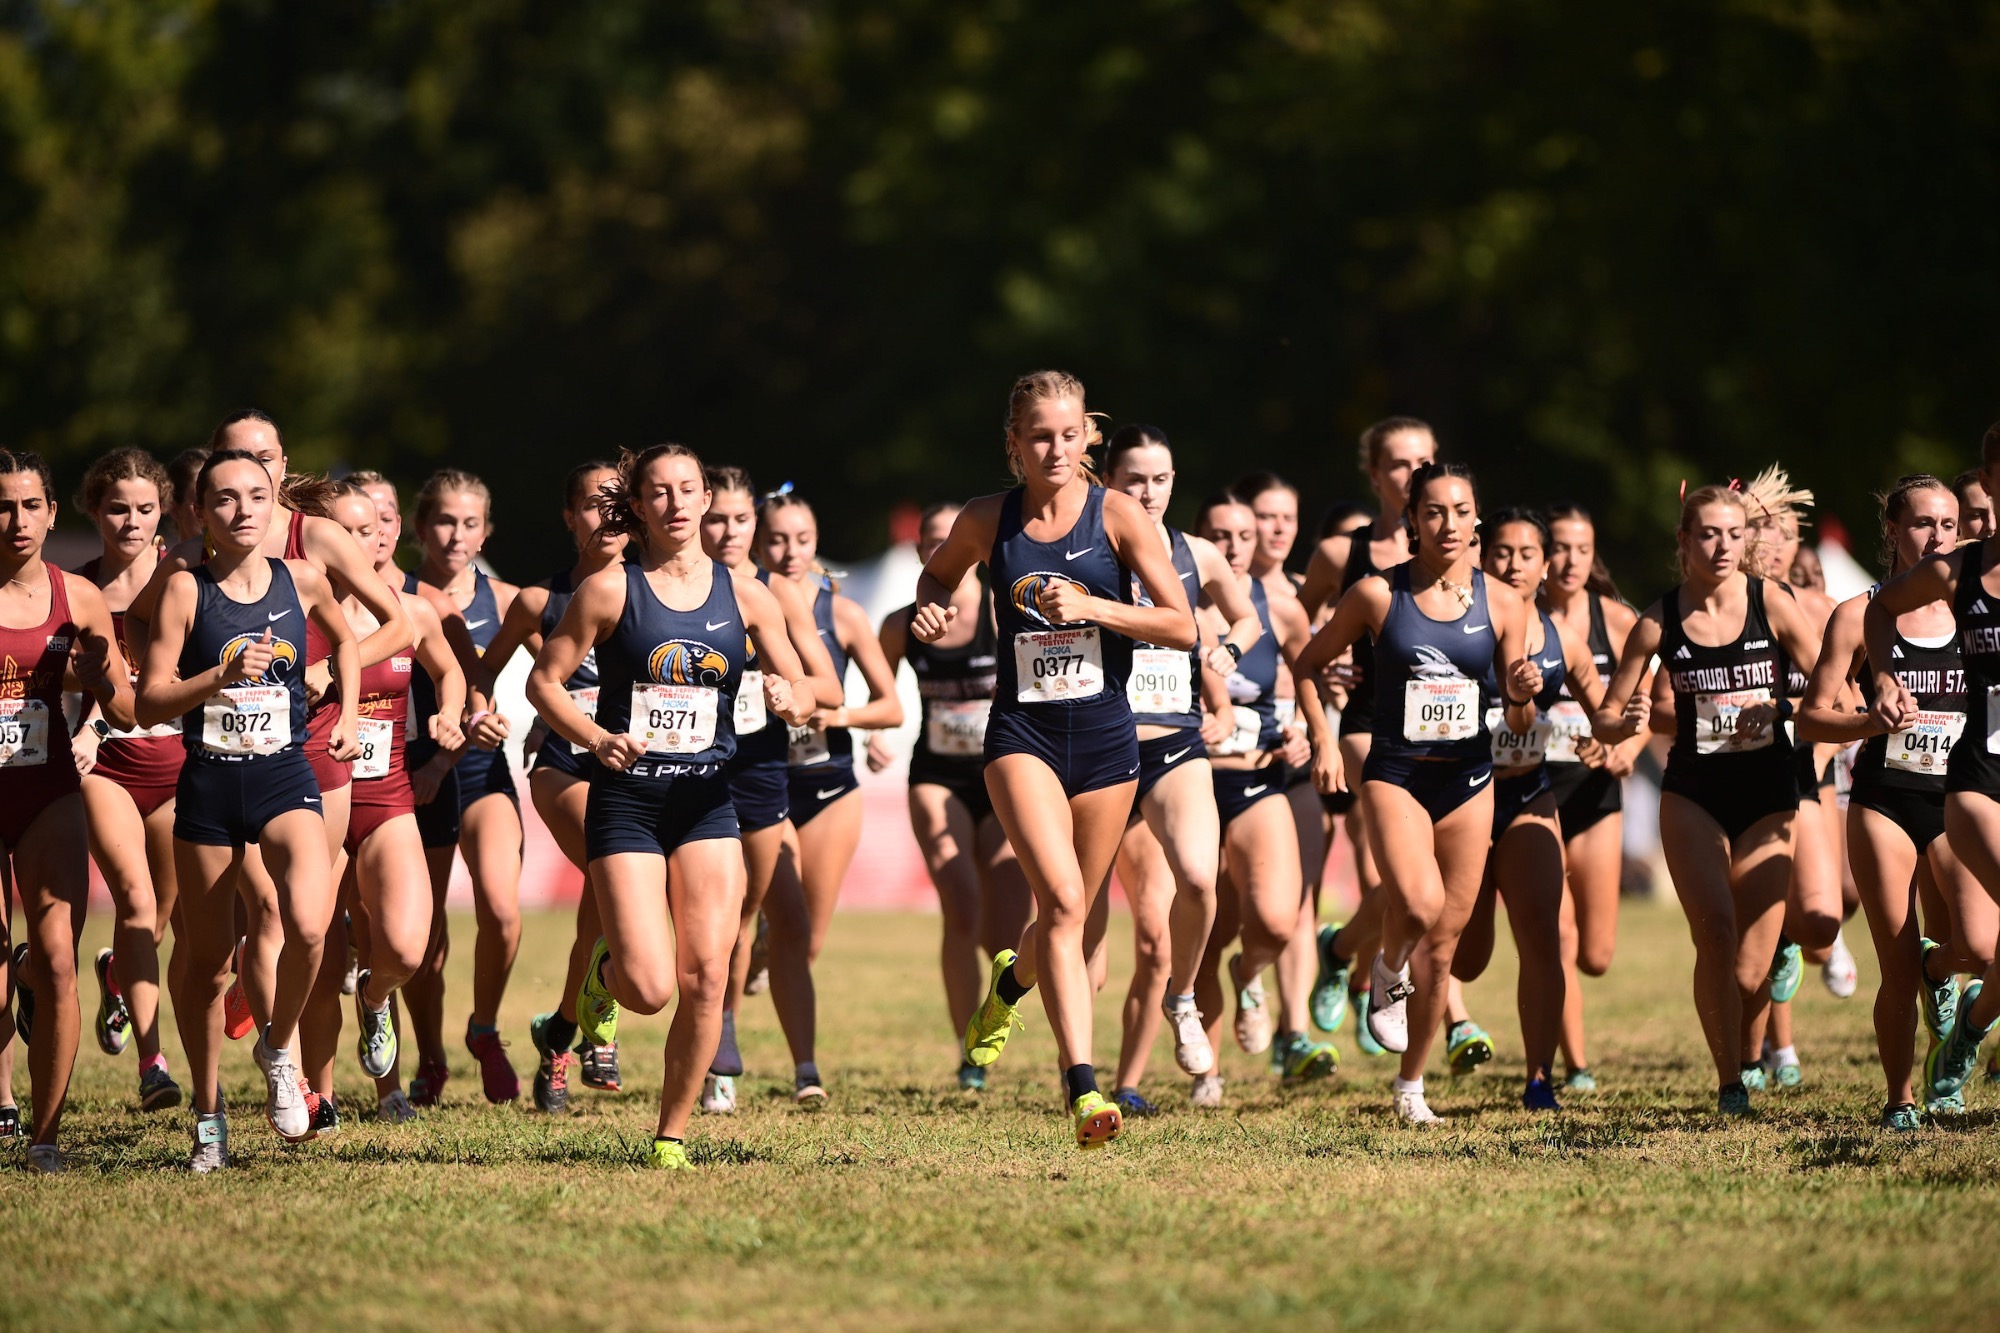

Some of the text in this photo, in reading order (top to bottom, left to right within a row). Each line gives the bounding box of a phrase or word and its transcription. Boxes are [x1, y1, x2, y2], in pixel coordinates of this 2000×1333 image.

[1031, 632, 1081, 642] CHILE PEPPER
[1039, 639, 1074, 647] FESTIVAL
[1043, 646, 1071, 655] HOKA
[1033, 654, 1084, 678] 0377
[1136, 674, 1177, 691] 0910
[1673, 660, 1774, 692] MISSOURI STATE
[234, 703, 261, 712] HOKA
[662, 700, 689, 709] HOKA
[1433, 695, 1457, 703] HOKA
[649, 709, 697, 729] 0371
[1422, 704, 1465, 721] 0912
[222, 712, 271, 733] 0372
[1712, 716, 1738, 733] 04
[1917, 725, 1942, 733] HOKA
[1904, 733, 1951, 753] 0414
